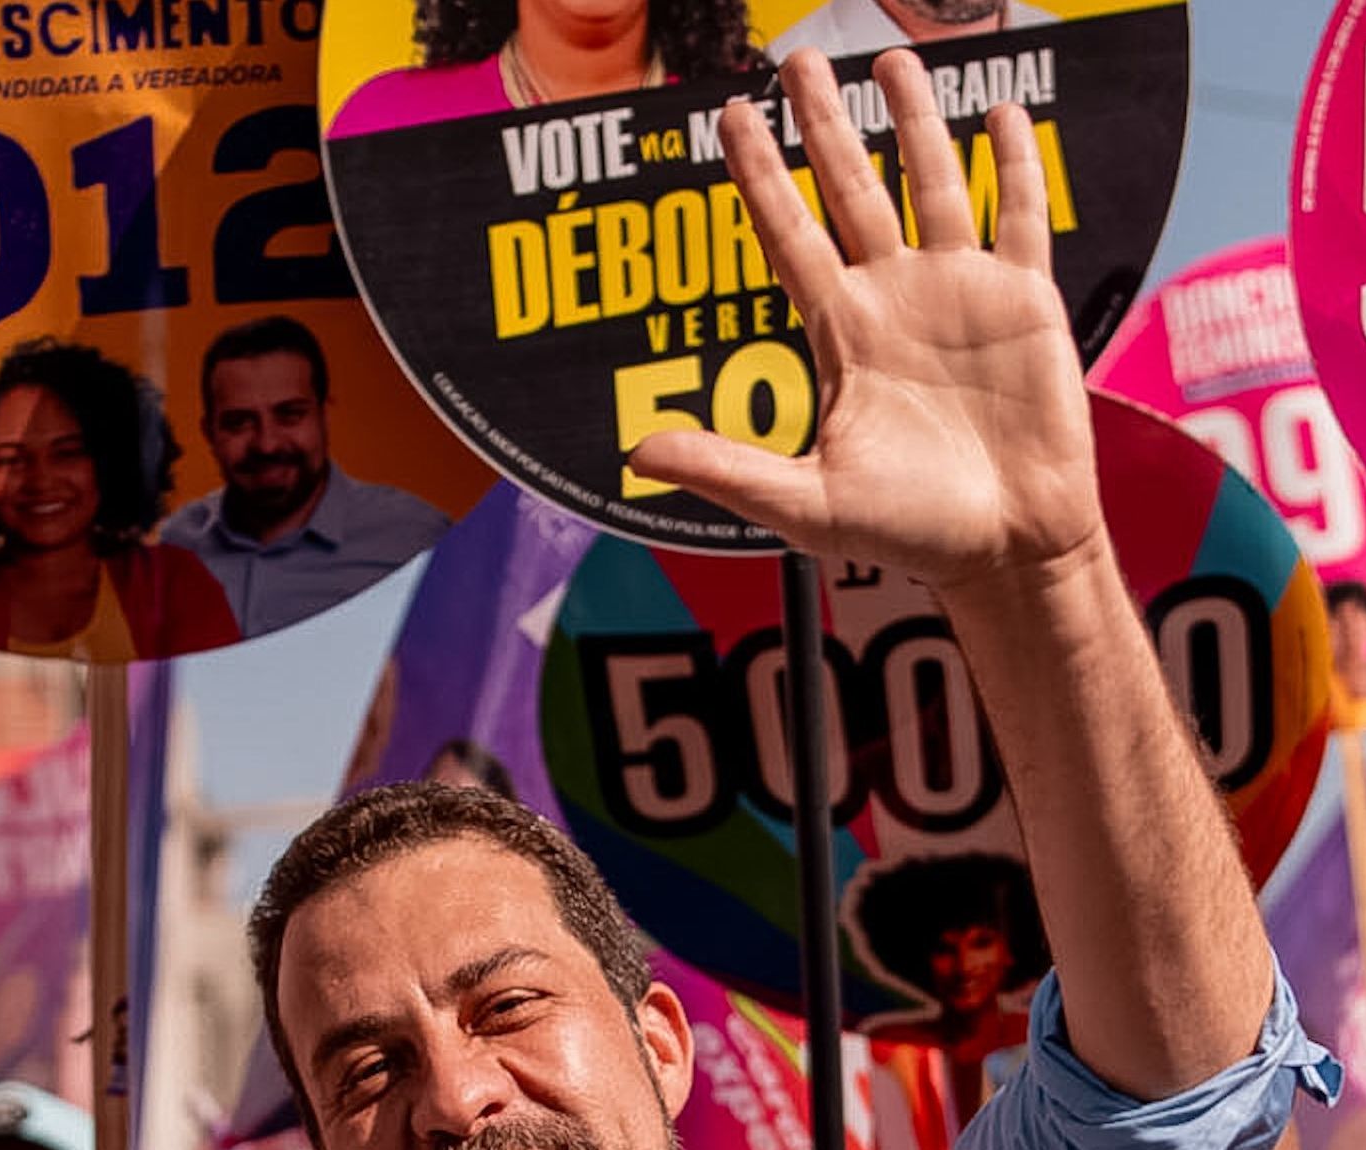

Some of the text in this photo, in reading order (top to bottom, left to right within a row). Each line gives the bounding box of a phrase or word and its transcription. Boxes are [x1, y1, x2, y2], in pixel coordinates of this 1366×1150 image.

[107, 74, 125, 91] A
[134, 64, 283, 90] VEREADORA
[502, 107, 636, 194] VOTE
[638, 130, 686, 163] na
[489, 170, 825, 338] DÉBOR
[614, 343, 813, 498] 50
[605, 596, 1253, 821] 5000
